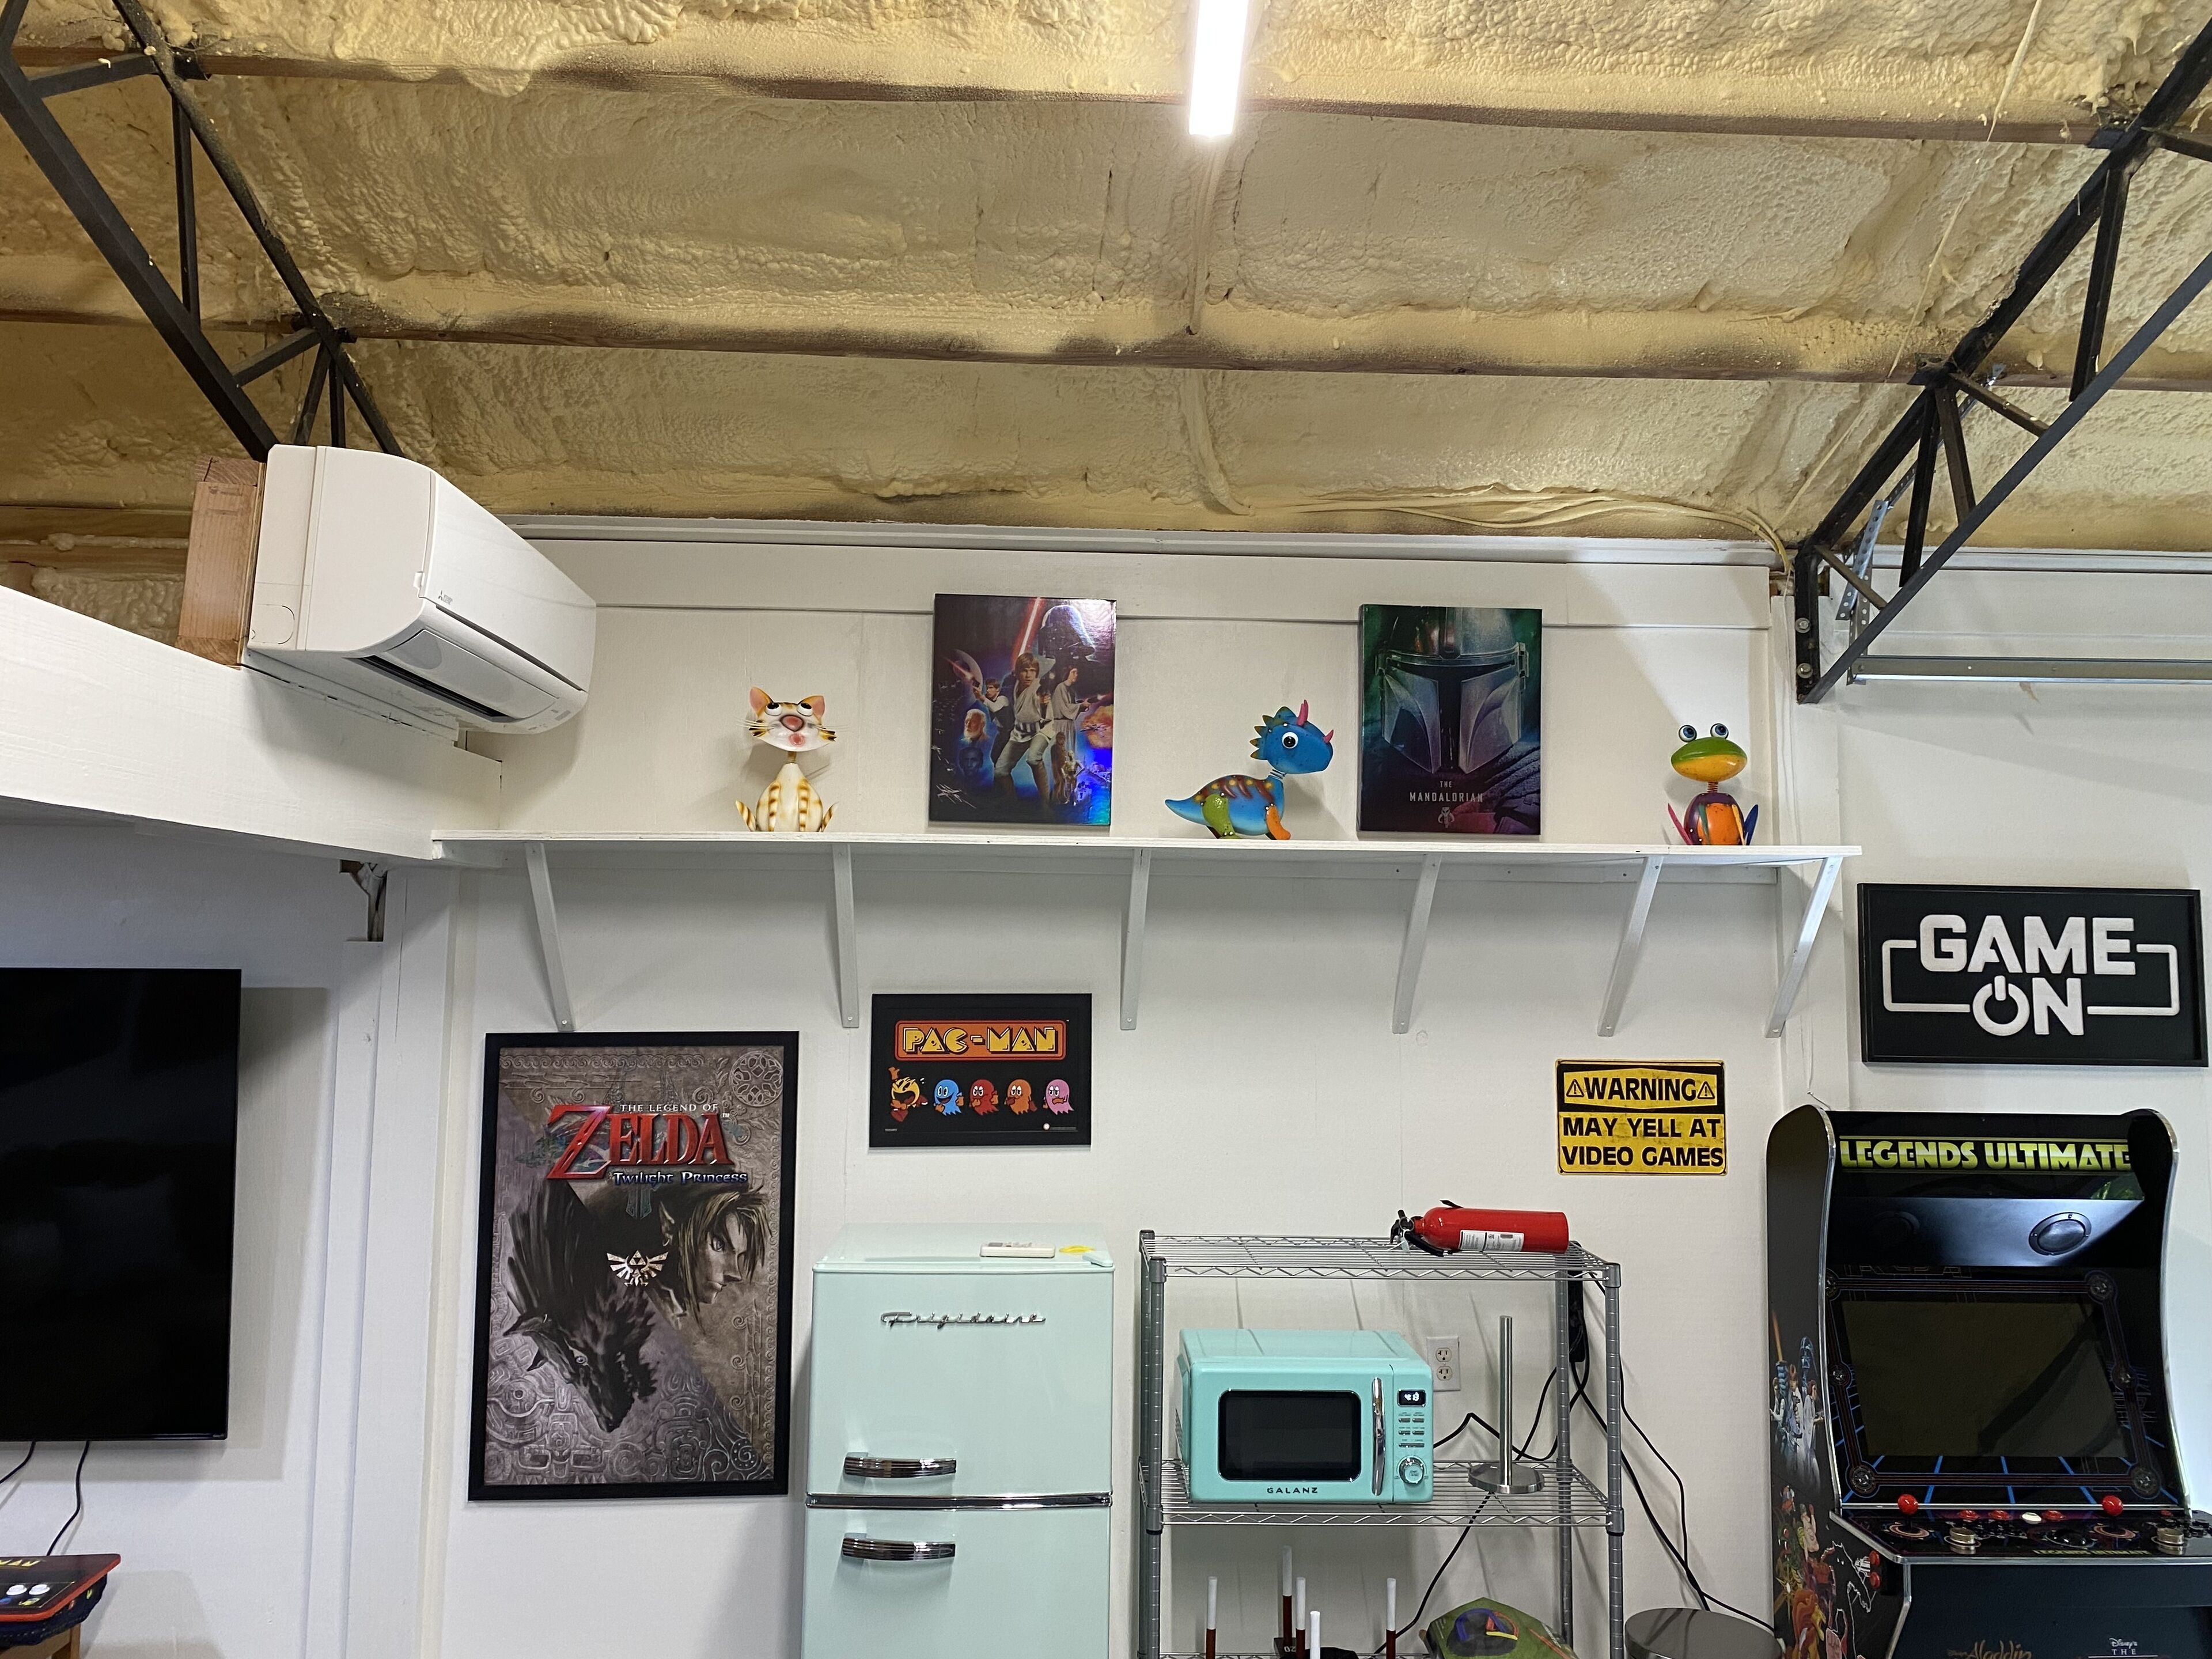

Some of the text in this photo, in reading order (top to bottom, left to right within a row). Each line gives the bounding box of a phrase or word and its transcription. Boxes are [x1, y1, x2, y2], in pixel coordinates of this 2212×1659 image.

[1409, 791, 1483, 802] MANDALORIAN
[1919, 914, 2136, 975] GAME
[1972, 975, 2084, 1036] ON
[903, 1027, 1058, 1055] PAC-MAN
[1584, 1077, 1696, 1102] WARNING
[620, 1103, 718, 1112] THE LEGEND OF
[1563, 1117, 1721, 1138] MAY YELL AT
[545, 1104, 736, 1180] ZELDA
[1561, 1146, 1724, 1167] VIDEO GAMES
[1839, 1140, 2131, 1171] LEGENDS ULTIMATE
[880, 1311, 1046, 1330] Frigidaire
